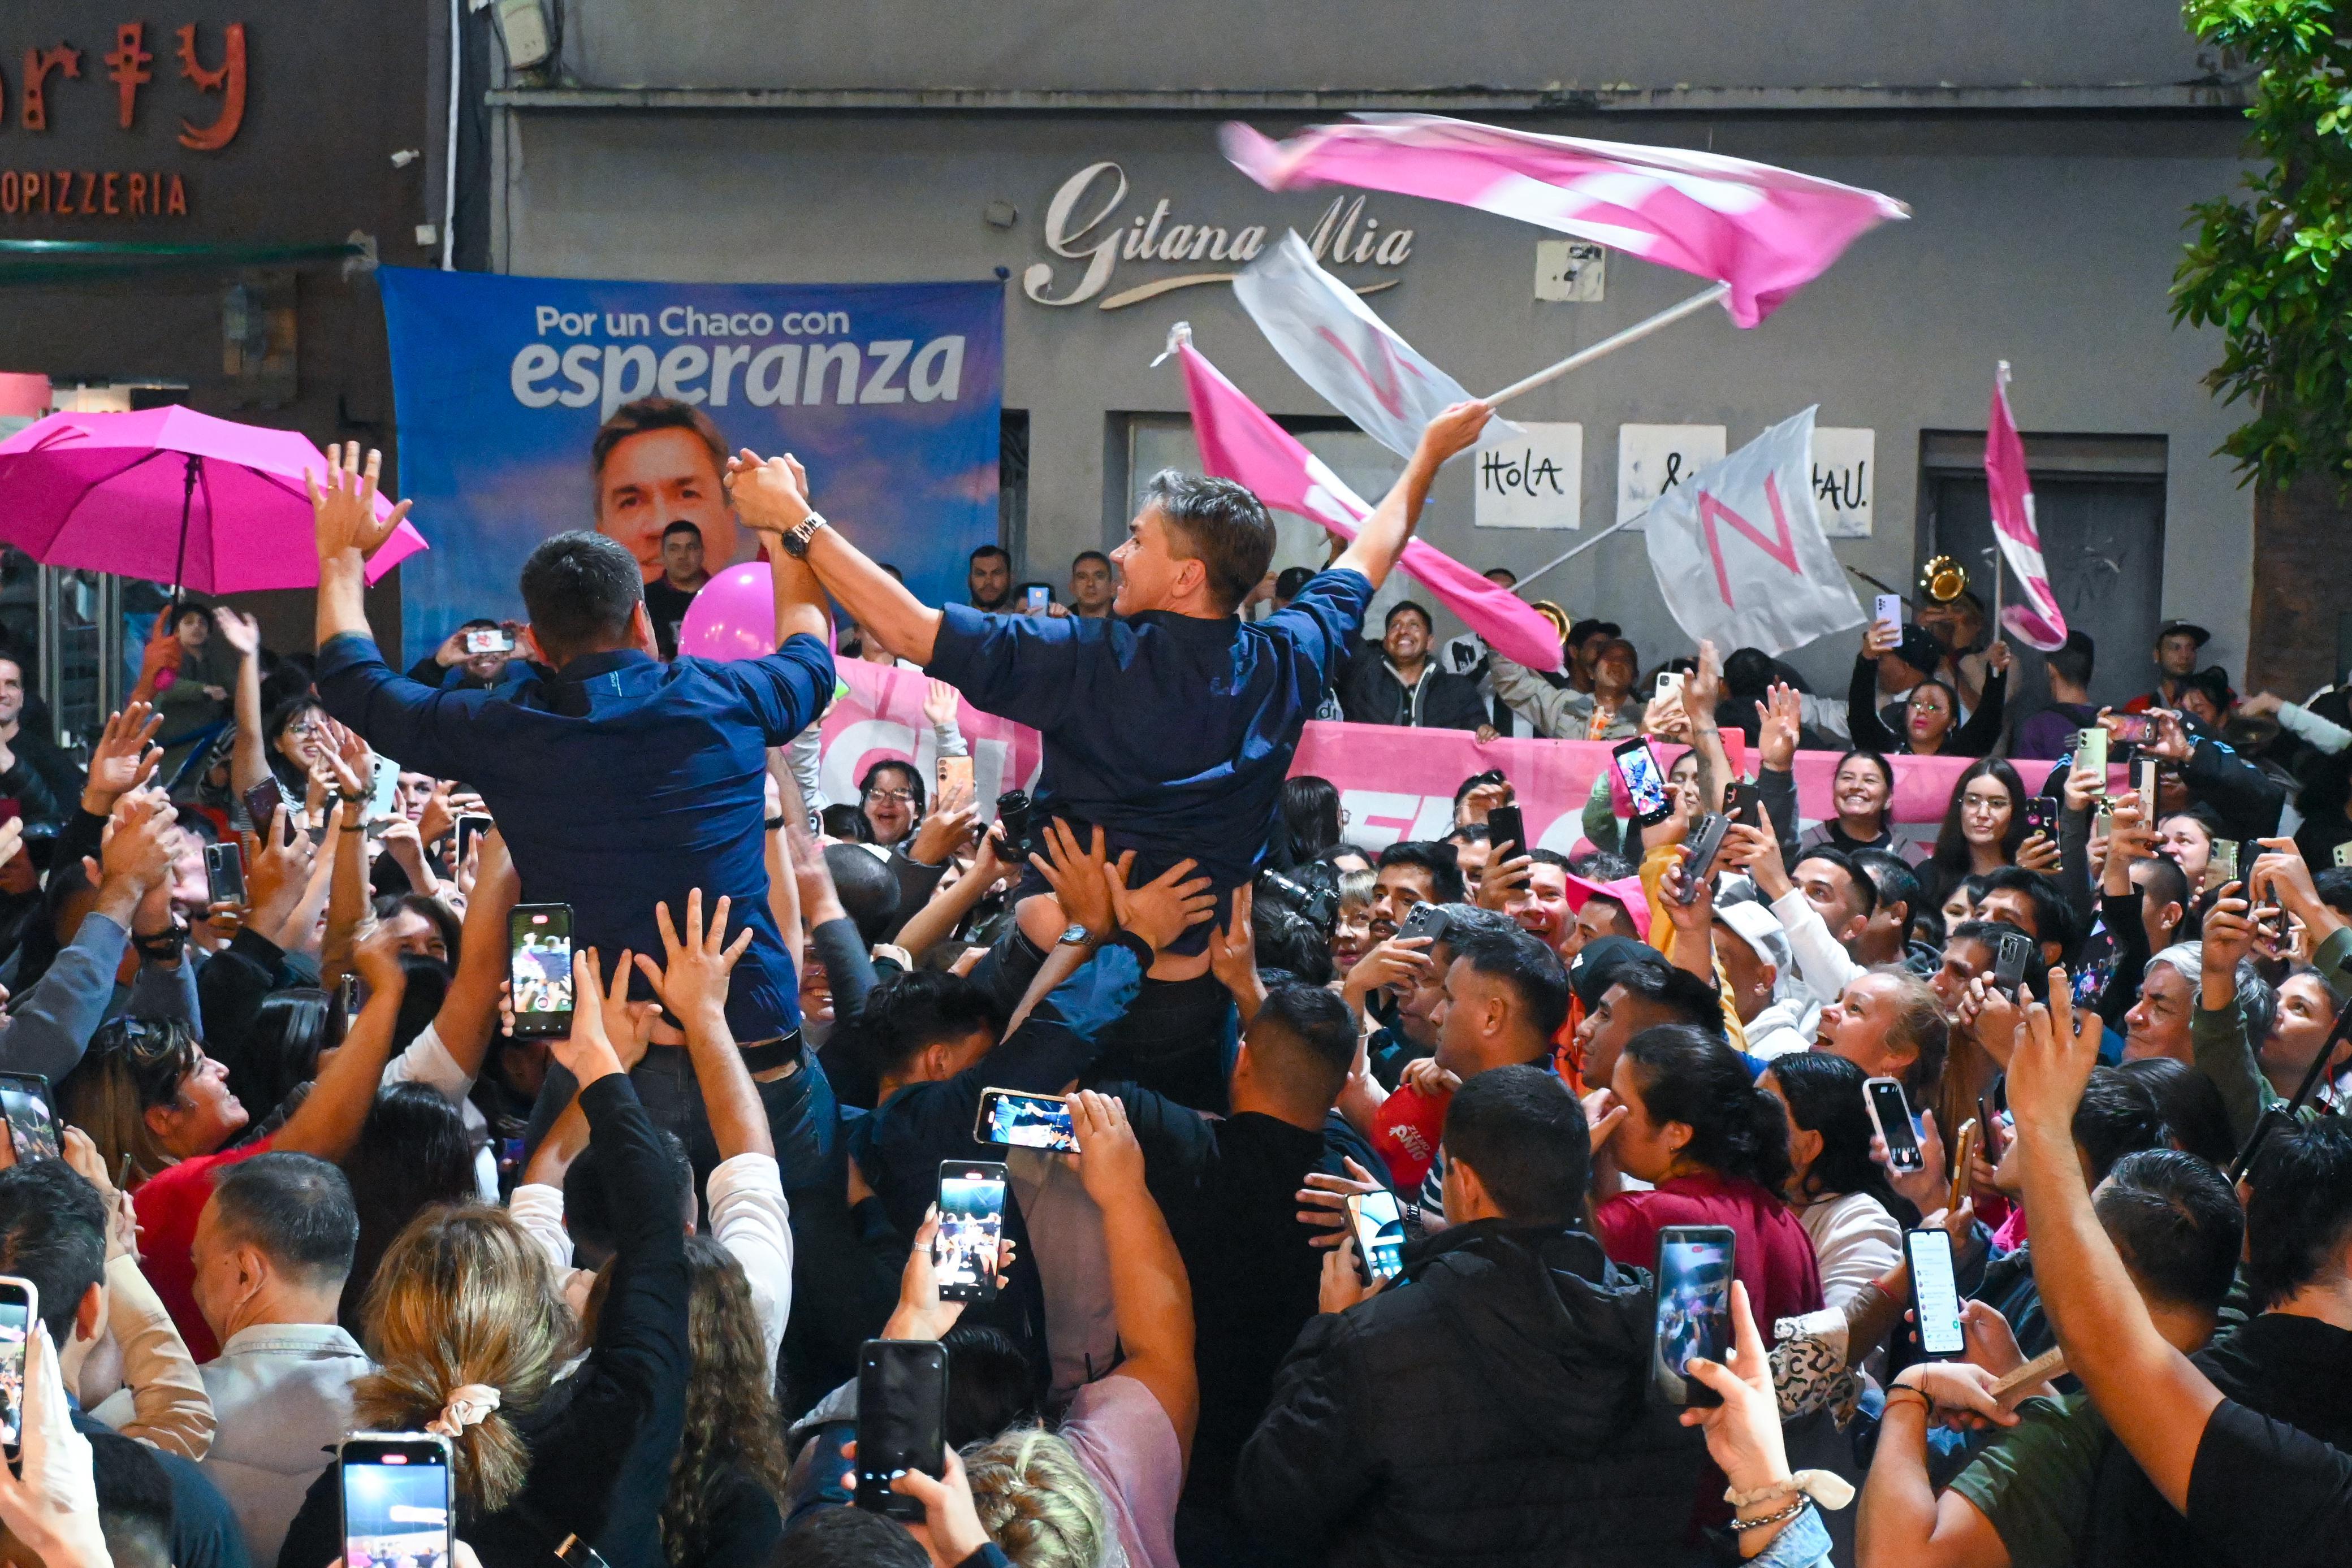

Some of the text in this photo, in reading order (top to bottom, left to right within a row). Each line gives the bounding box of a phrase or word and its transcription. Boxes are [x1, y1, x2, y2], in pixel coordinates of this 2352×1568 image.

[0, 20, 247, 151] rty
[1, 170, 187, 216] OPIZZERIA
[1023, 161, 1416, 306] Gitana Mia
[535, 306, 849, 337] Por un Chaco con
[511, 334, 966, 427] esperanza
[1697, 469, 1802, 610] N
